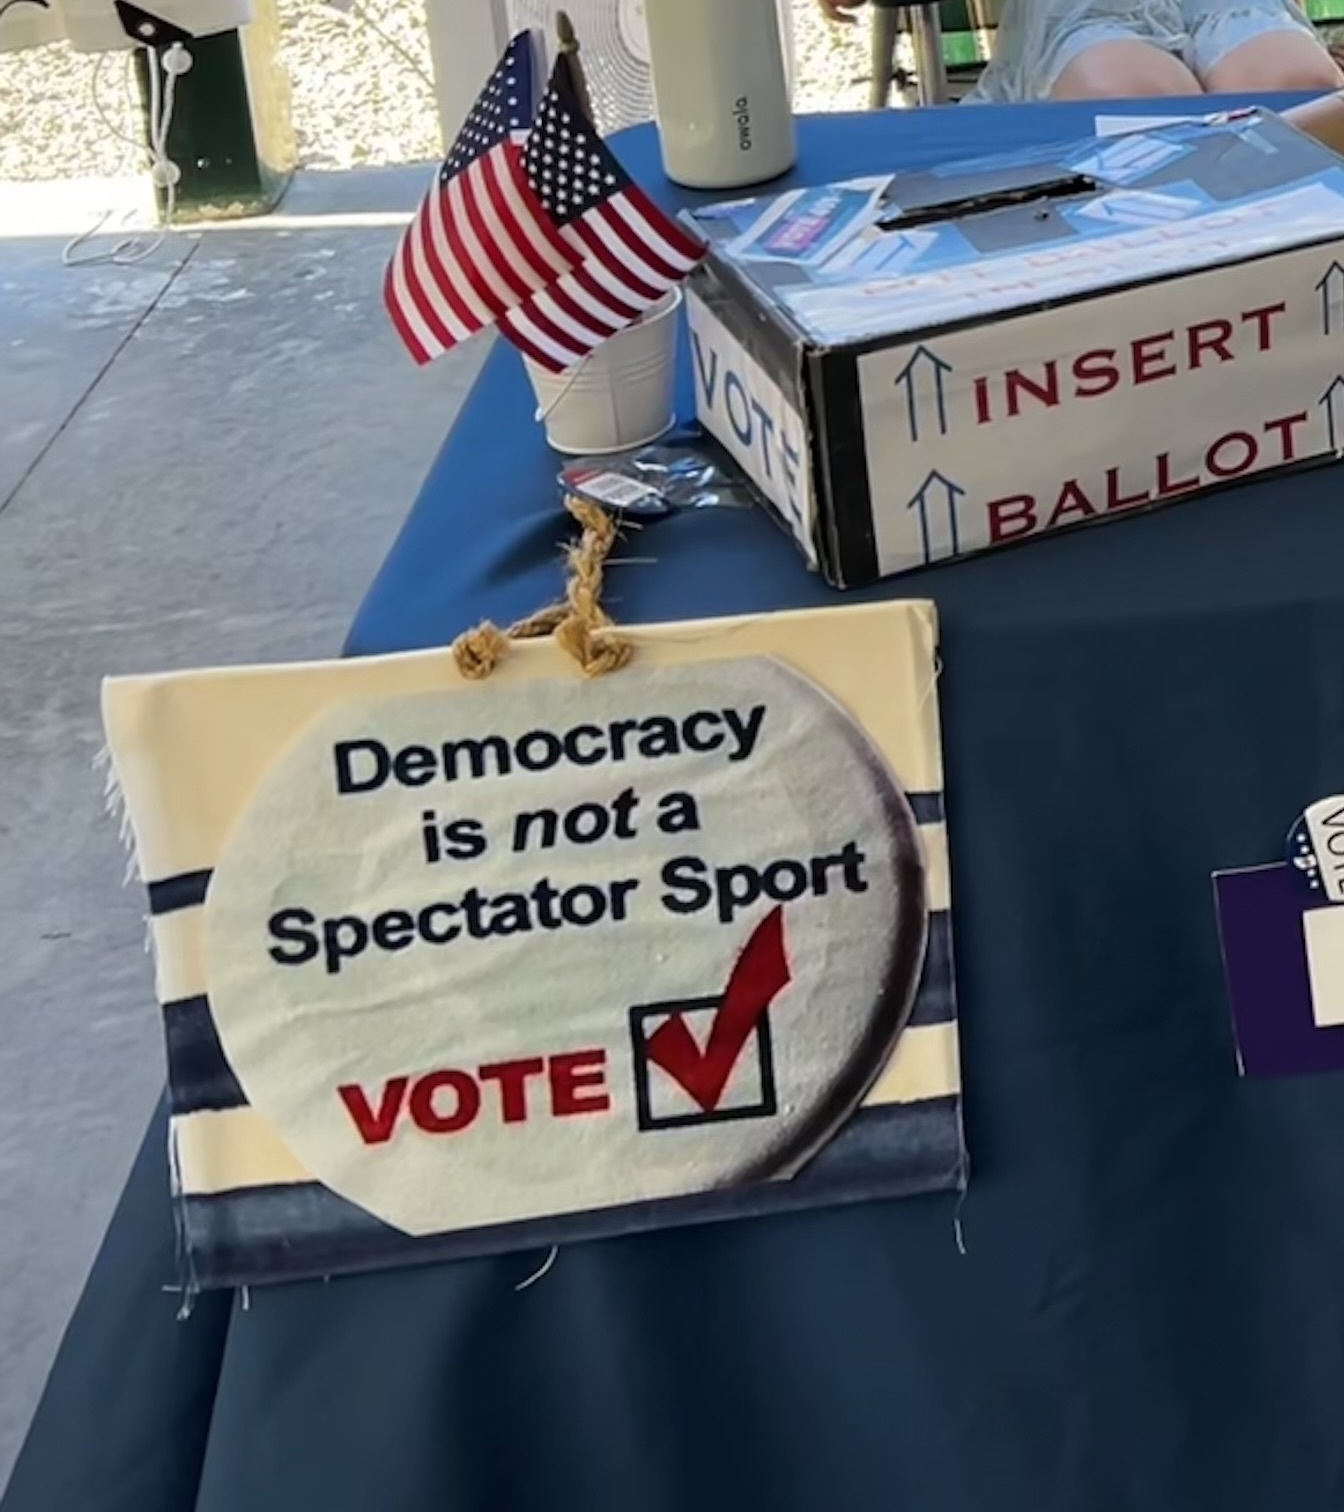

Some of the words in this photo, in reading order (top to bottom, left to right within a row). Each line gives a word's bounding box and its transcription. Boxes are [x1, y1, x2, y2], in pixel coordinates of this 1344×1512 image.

[733, 96, 752, 151] owala
[971, 301, 1288, 426] INSERT
[985, 410, 1309, 546] BALLOT
[332, 704, 767, 795] Democracy
[420, 810, 489, 863] is
[511, 787, 641, 854] not
[656, 791, 701, 834] a
[265, 876, 640, 975] Spectator
[659, 840, 869, 924] Sport
[338, 1049, 611, 1147] VOTE
